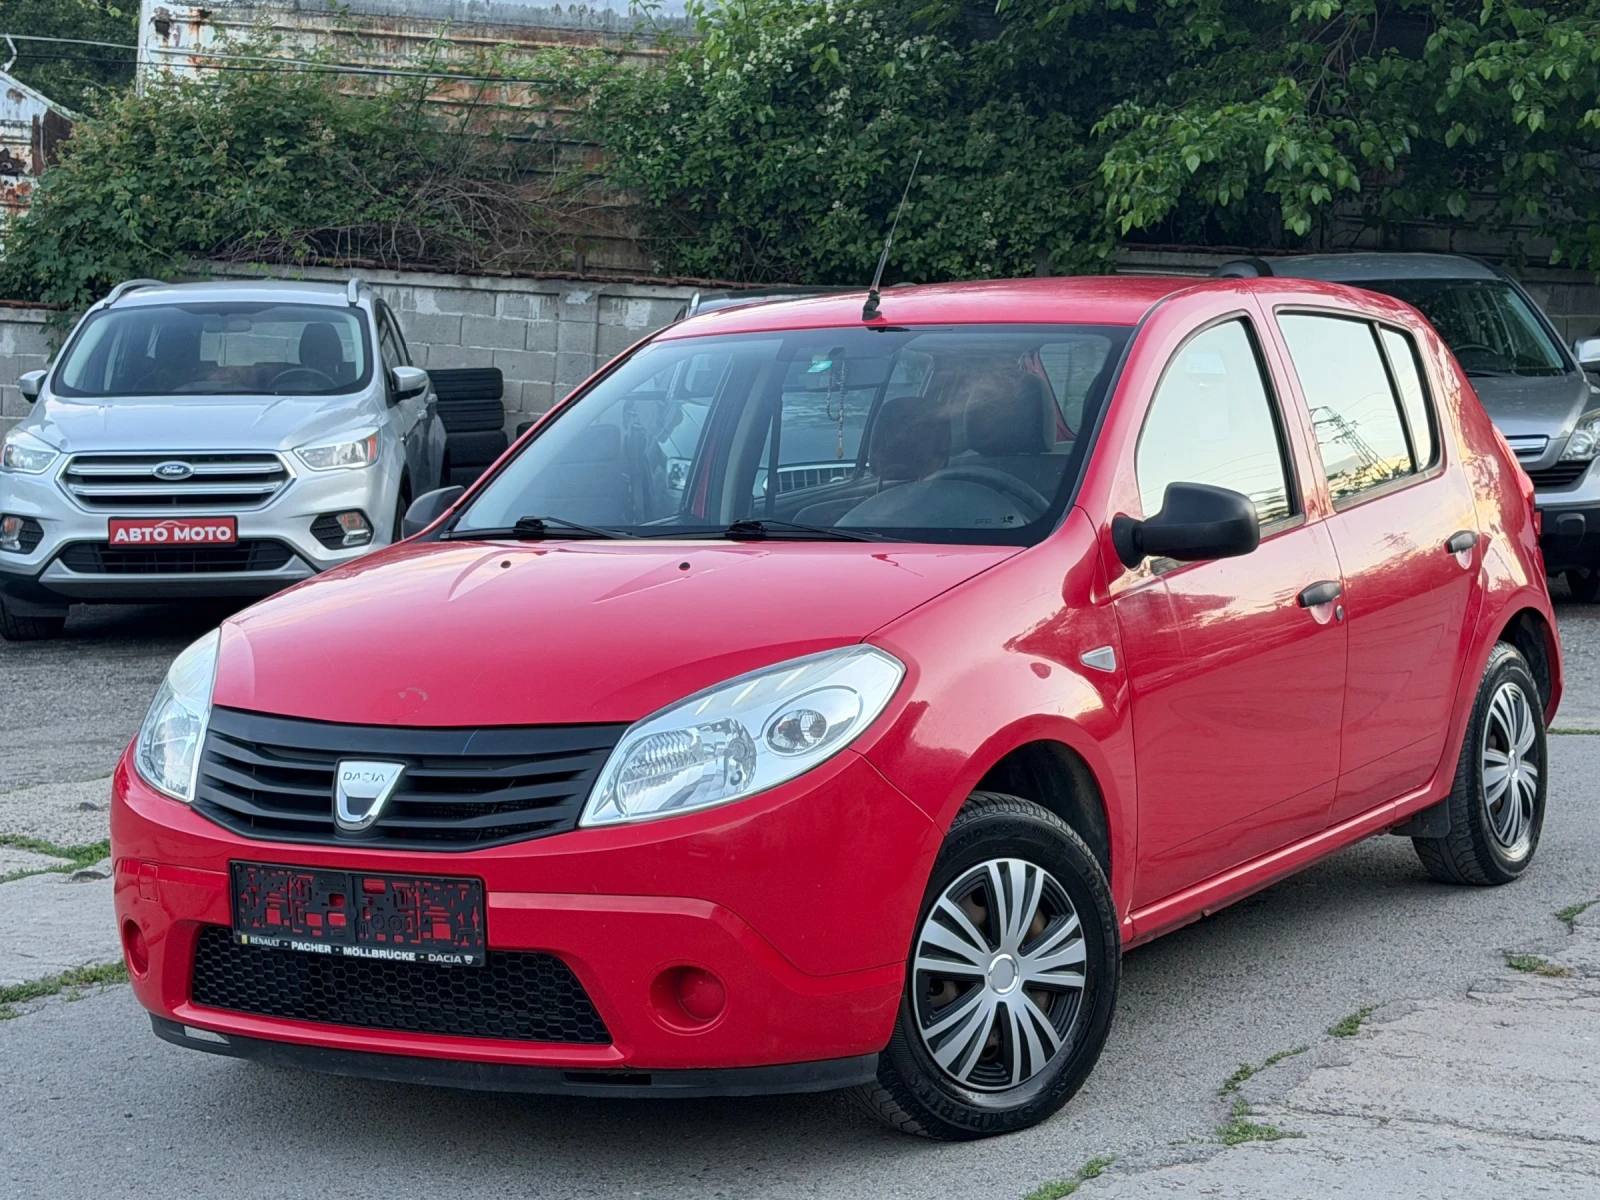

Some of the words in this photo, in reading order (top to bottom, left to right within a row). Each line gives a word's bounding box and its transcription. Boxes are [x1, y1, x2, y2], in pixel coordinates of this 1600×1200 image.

[114, 528, 168, 542] АВТО
[174, 526, 231, 541] МОТО
[342, 771, 385, 783] DACIA
[250, 936, 281, 947] RENAULT
[291, 941, 332, 954] PACHER
[343, 946, 416, 961] MÖLLBRÜCKE
[428, 953, 462, 963] DACIA
